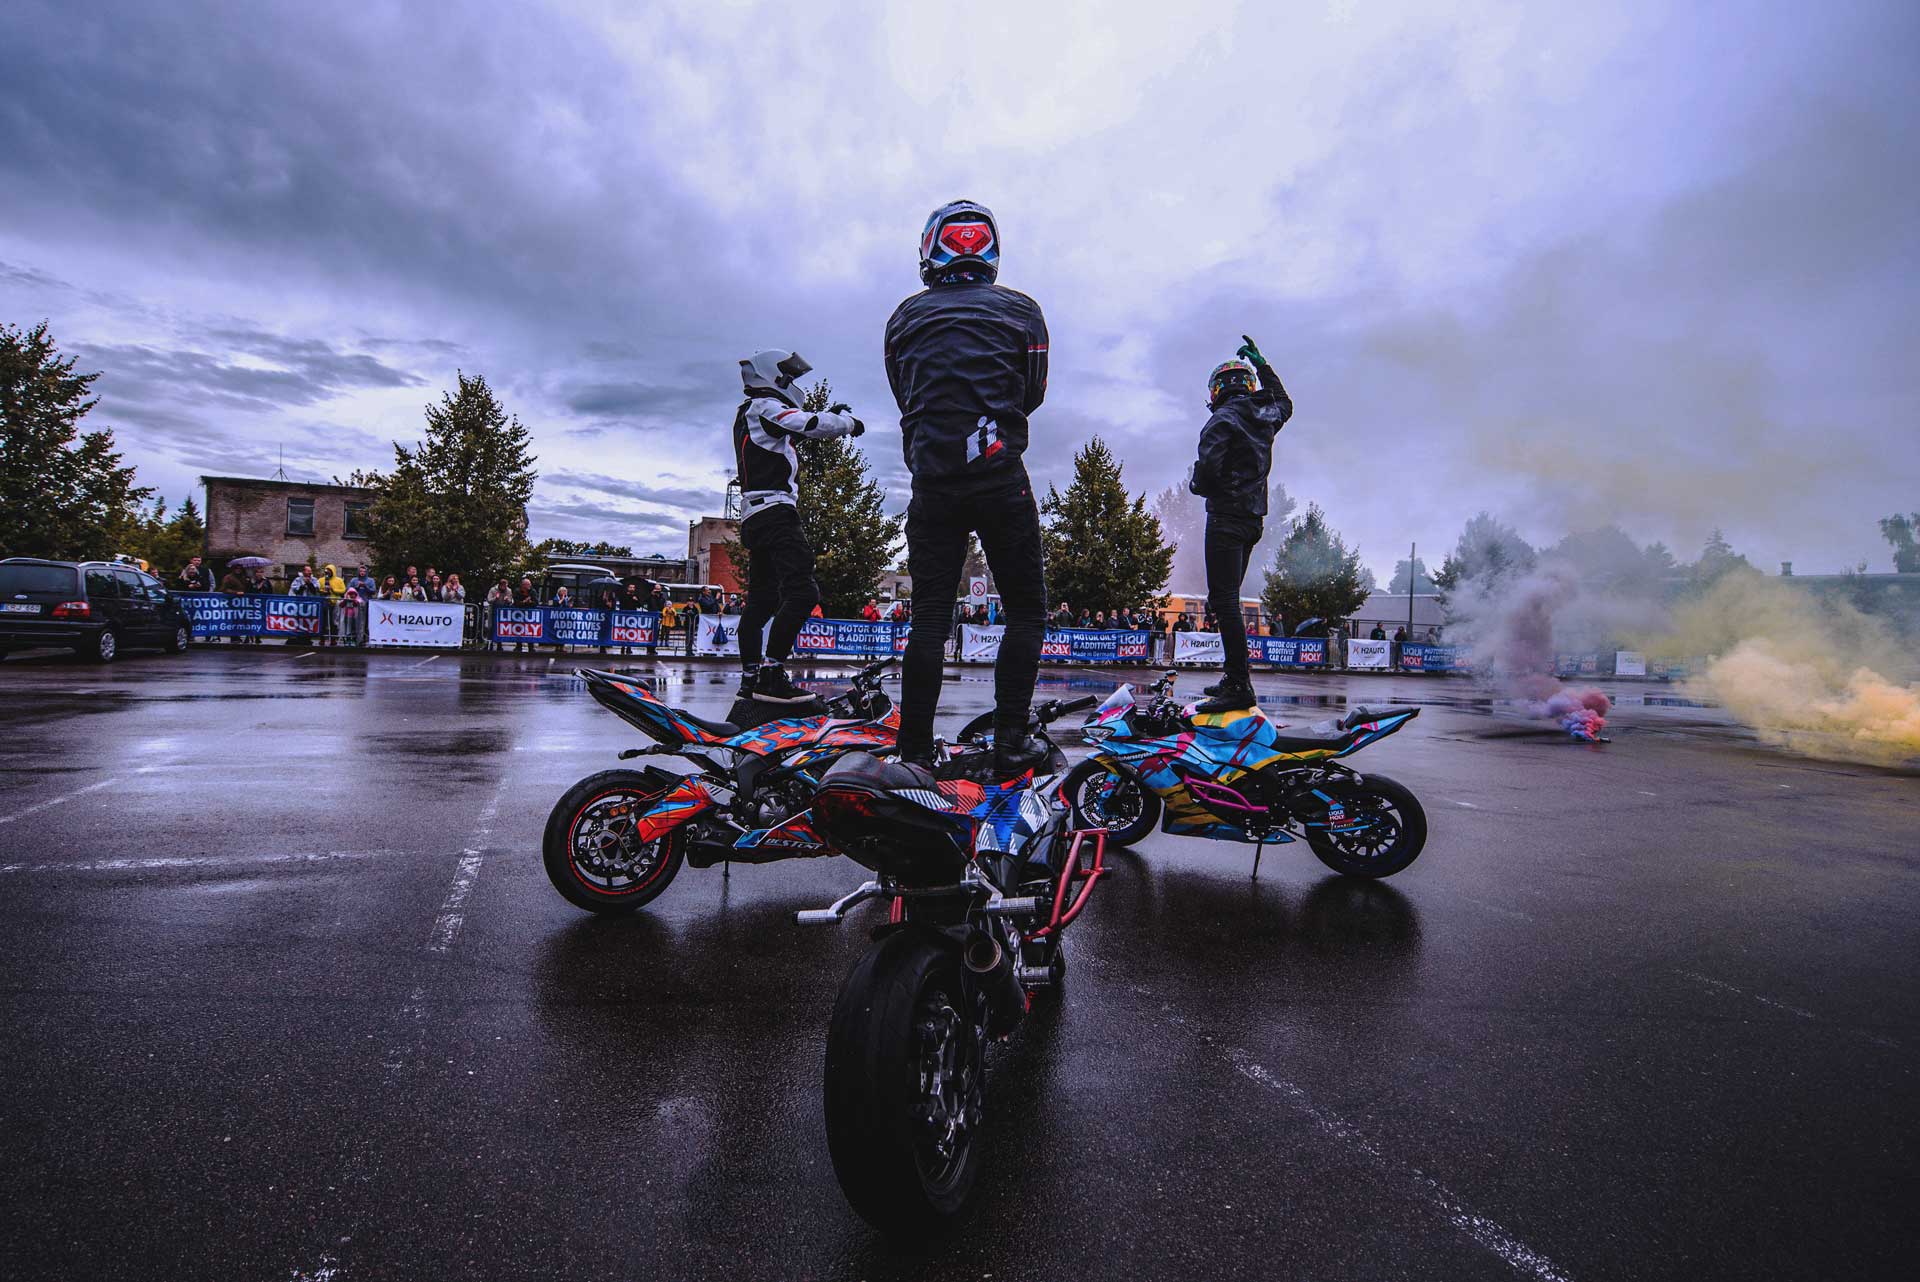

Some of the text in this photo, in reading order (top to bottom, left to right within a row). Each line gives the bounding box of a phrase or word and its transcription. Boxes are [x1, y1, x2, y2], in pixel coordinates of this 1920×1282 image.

[181, 597, 262, 608] MOTOR OILS
[193, 609, 262, 620] ADDITIVES
[269, 602, 318, 616] LIQUI
[398, 614, 453, 627] H2AUTO
[499, 610, 541, 623] LIQUI
[550, 610, 606, 622] MOTOR OILS
[614, 615, 653, 628] LIQUI
[209, 623, 218, 631] in
[220, 623, 262, 632] Germany
[269, 616, 319, 631] MOLY
[553, 620, 601, 631] ADDITIVES
[800, 623, 834, 635] LIQUI
[838, 624, 870, 634] MOTOR
[872, 625, 892, 634] OILS
[499, 623, 542, 636] MOLY
[556, 630, 599, 640] CAR CARE
[613, 628, 653, 641] MOLY
[800, 637, 834, 648] MOLY
[846, 634, 892, 643] ADDITIVES
[1120, 635, 1146, 644] LIQUI
[1190, 639, 1220, 648] H2AUTO
[1042, 643, 1070, 655] MOLY
[1080, 641, 1117, 650] ADDITIVES
[1120, 645, 1146, 655] MOLY
[1301, 643, 1322, 652] LIQUI
[1403, 647, 1422, 655] LIQUI
[1301, 652, 1321, 662] MOLY
[1403, 656, 1422, 665] MOLY
